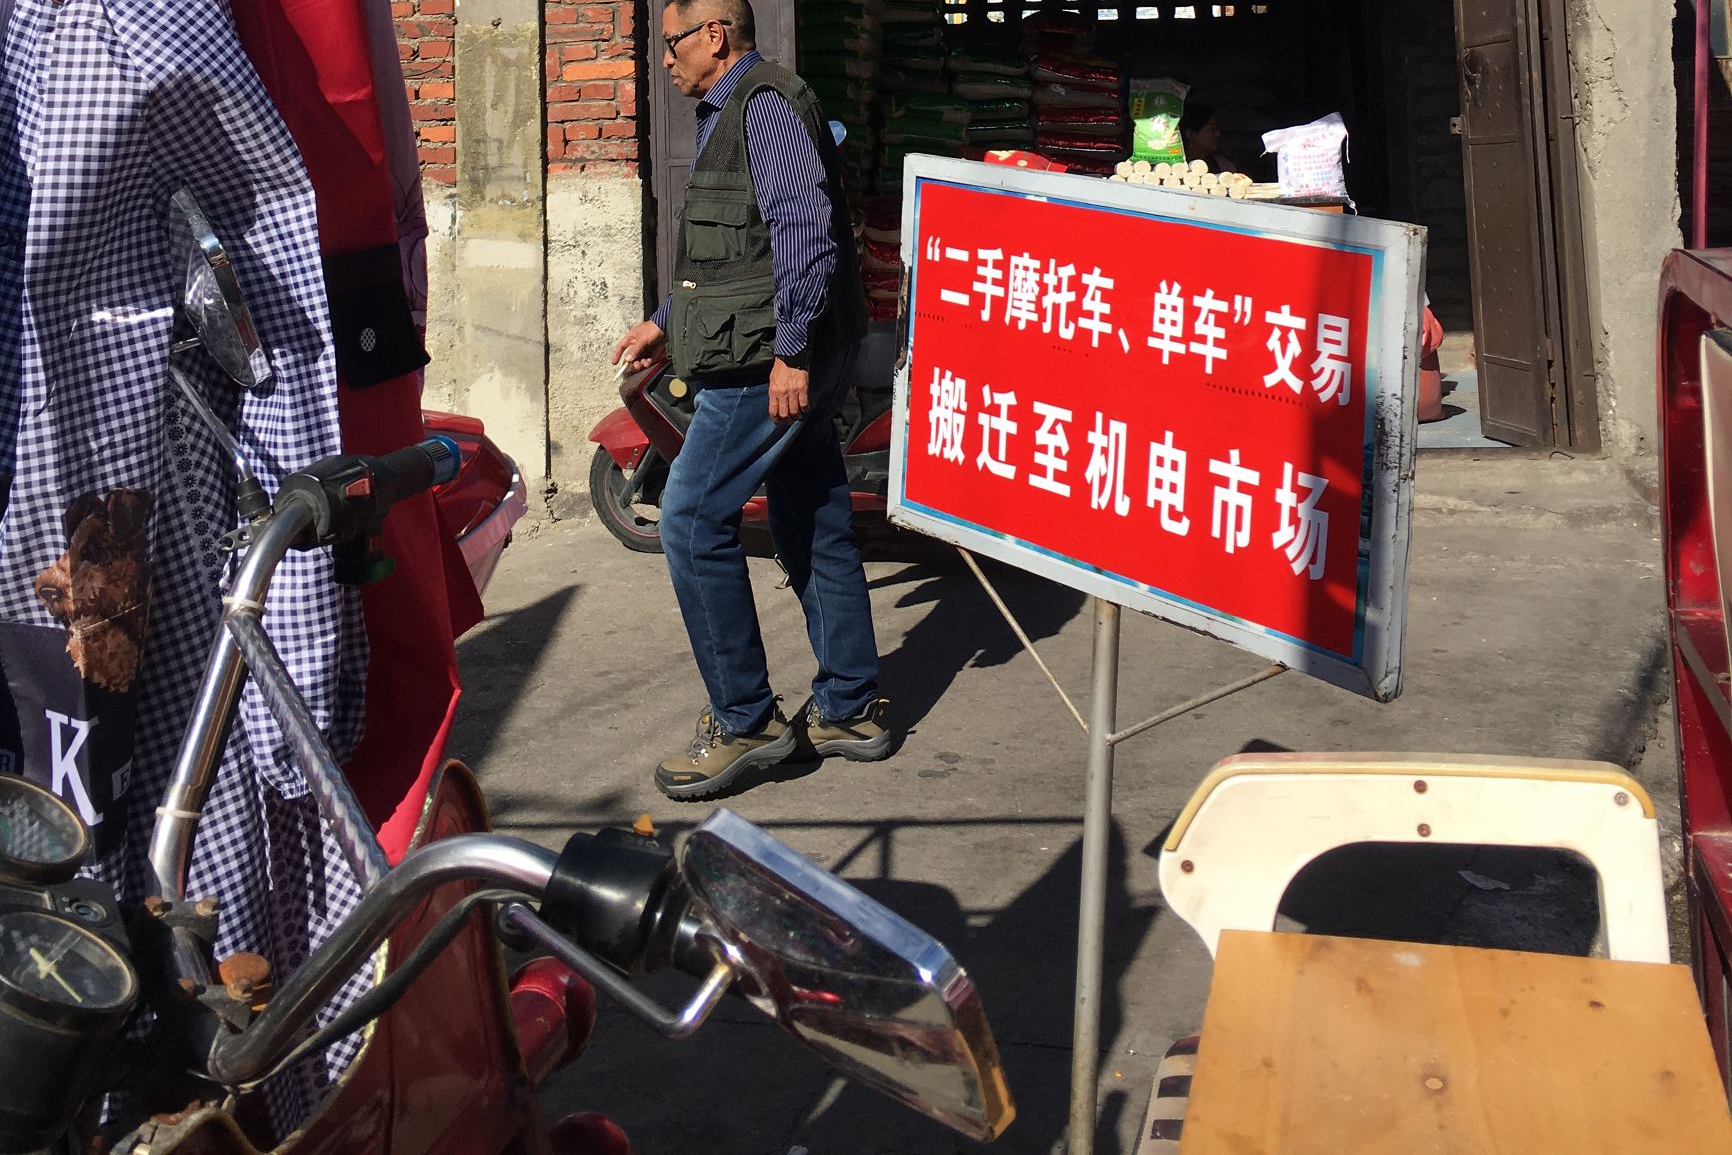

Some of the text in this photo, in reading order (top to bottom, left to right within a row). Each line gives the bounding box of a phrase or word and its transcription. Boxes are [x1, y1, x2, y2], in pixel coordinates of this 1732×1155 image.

[928, 367, 1330, 580] 搬迁至机电市场
